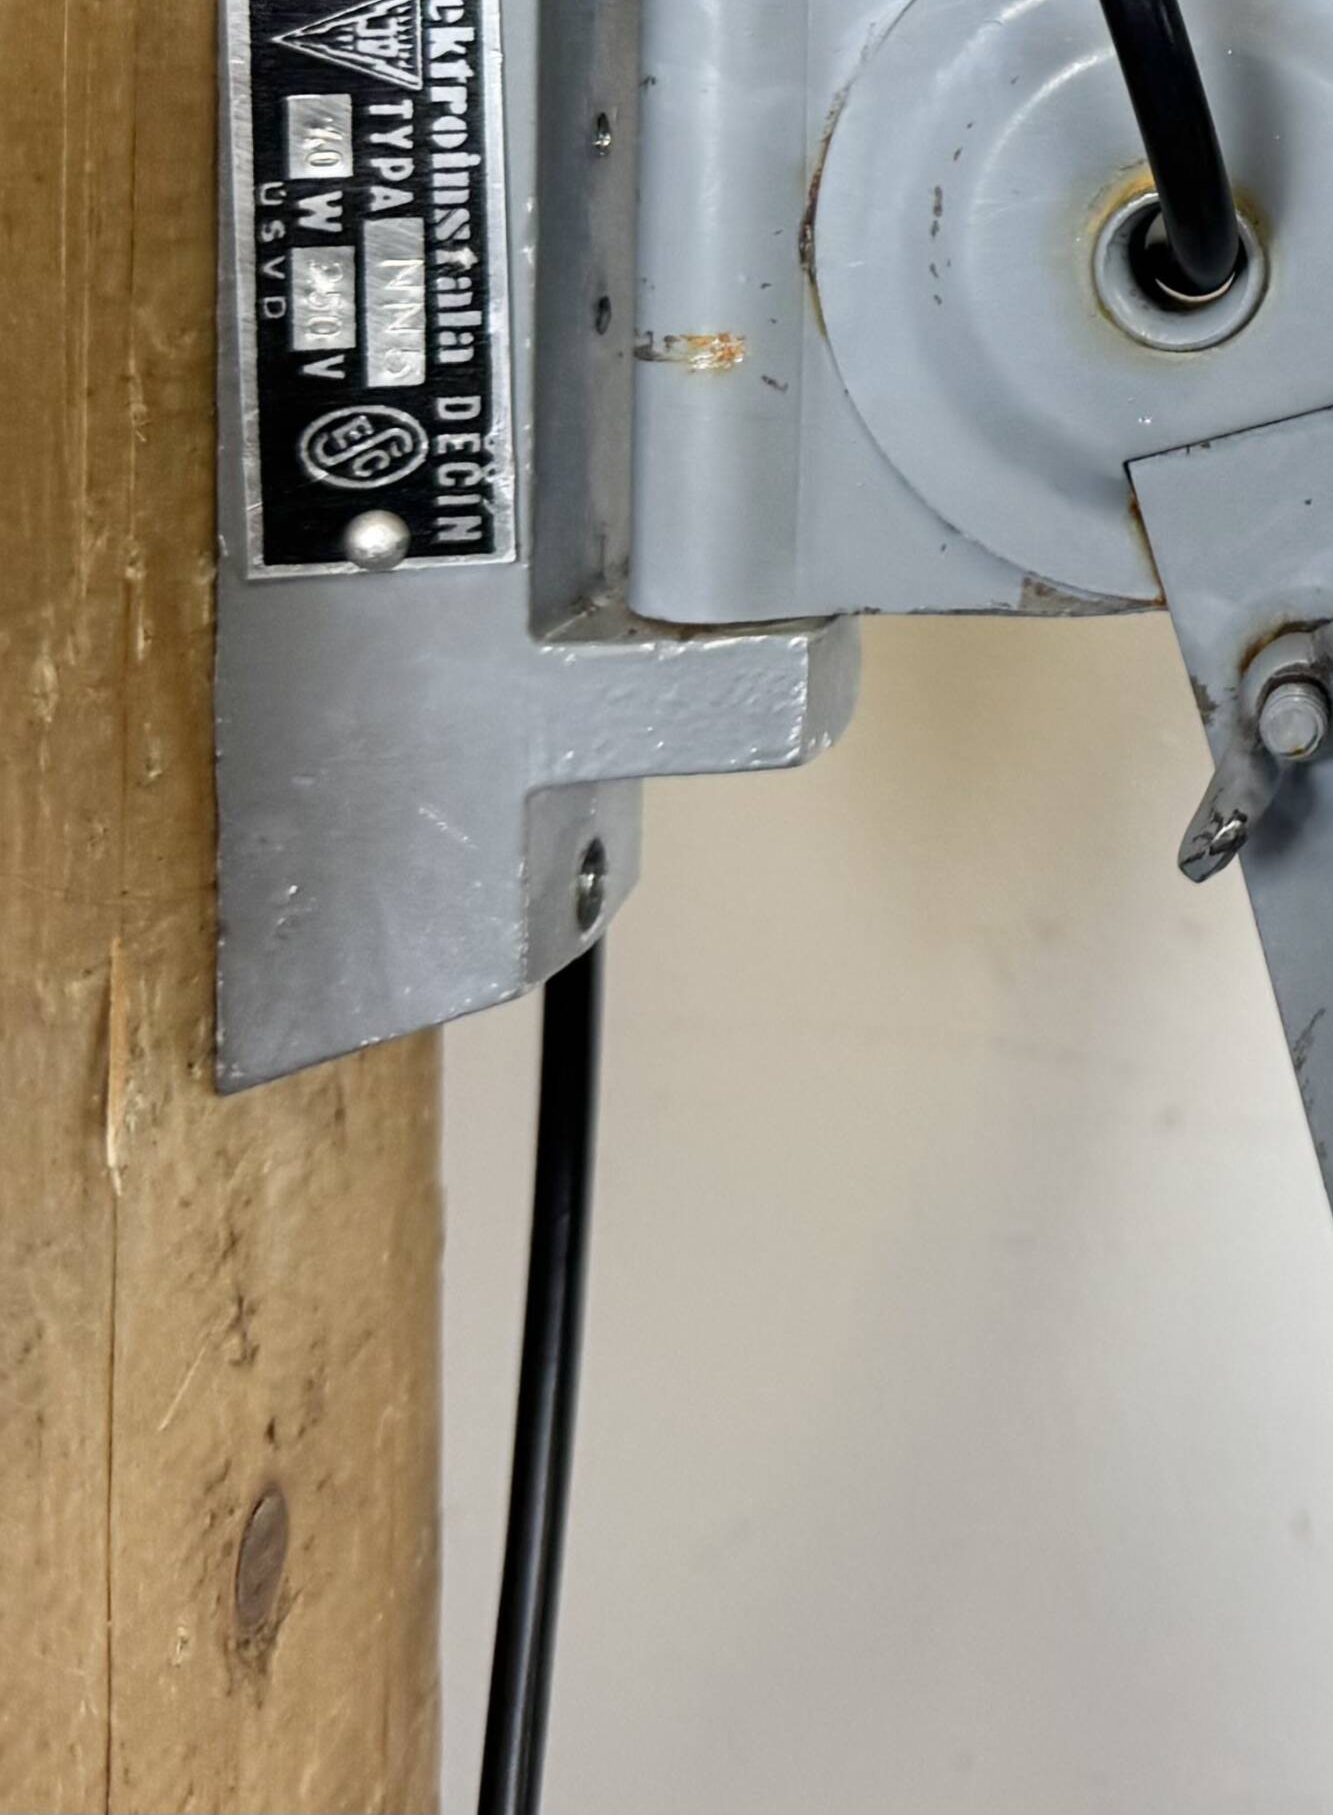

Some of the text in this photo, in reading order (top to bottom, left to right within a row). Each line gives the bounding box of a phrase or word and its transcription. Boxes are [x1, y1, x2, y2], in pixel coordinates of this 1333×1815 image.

[369, 100, 415, 211] TYPA
[299, 192, 343, 233] W
[303, 355, 344, 379] V
